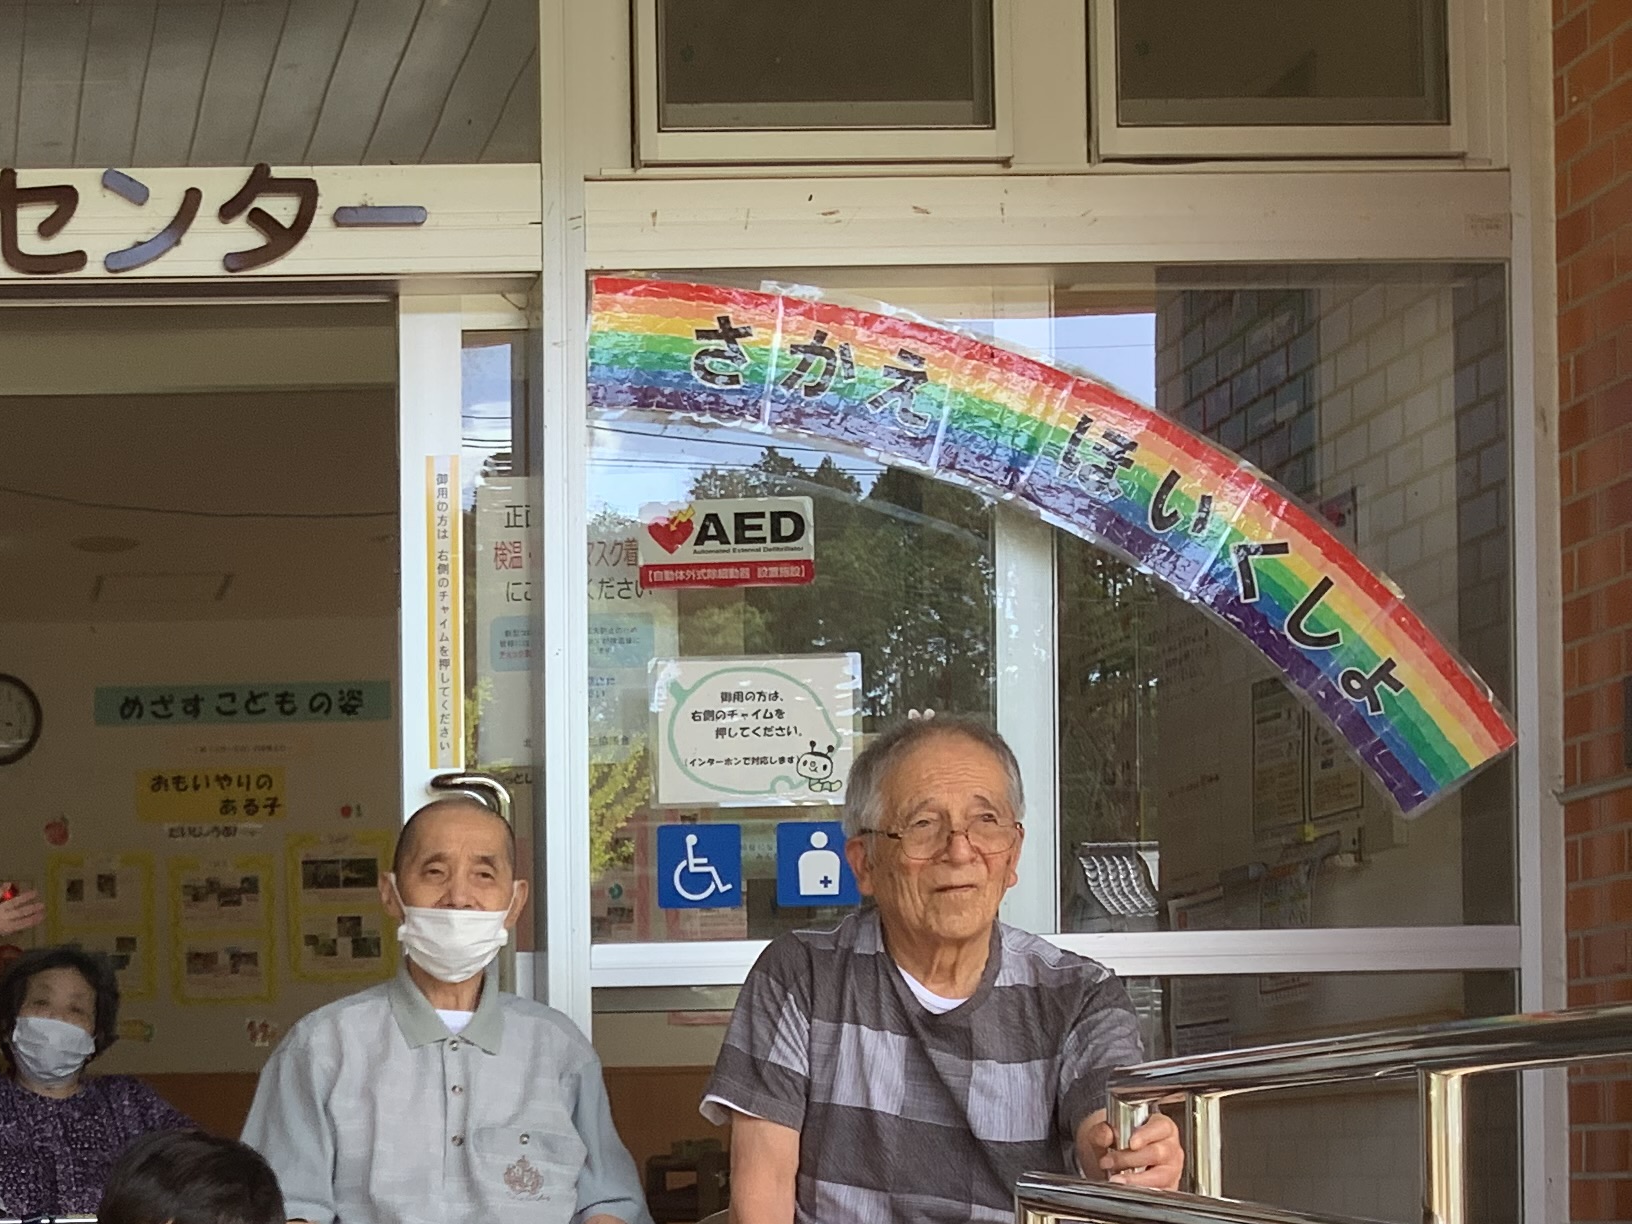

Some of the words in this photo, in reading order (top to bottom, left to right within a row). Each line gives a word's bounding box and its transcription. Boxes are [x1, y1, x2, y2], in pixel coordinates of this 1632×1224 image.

[436, 473, 449, 540] 御用の方は
[690, 315, 939, 429] さかえ
[1056, 411, 1405, 717] ほいくしょ
[693, 511, 805, 546] AED
[437, 549, 452, 751] 右側のチャイムを押してください
[720, 691, 784, 703] 御用の方は、
[691, 709, 786, 722] 右側のチャイムを
[715, 726, 803, 739] 押してください。
[150, 774, 273, 791] おもいやりの
[219, 797, 282, 816] ある子
